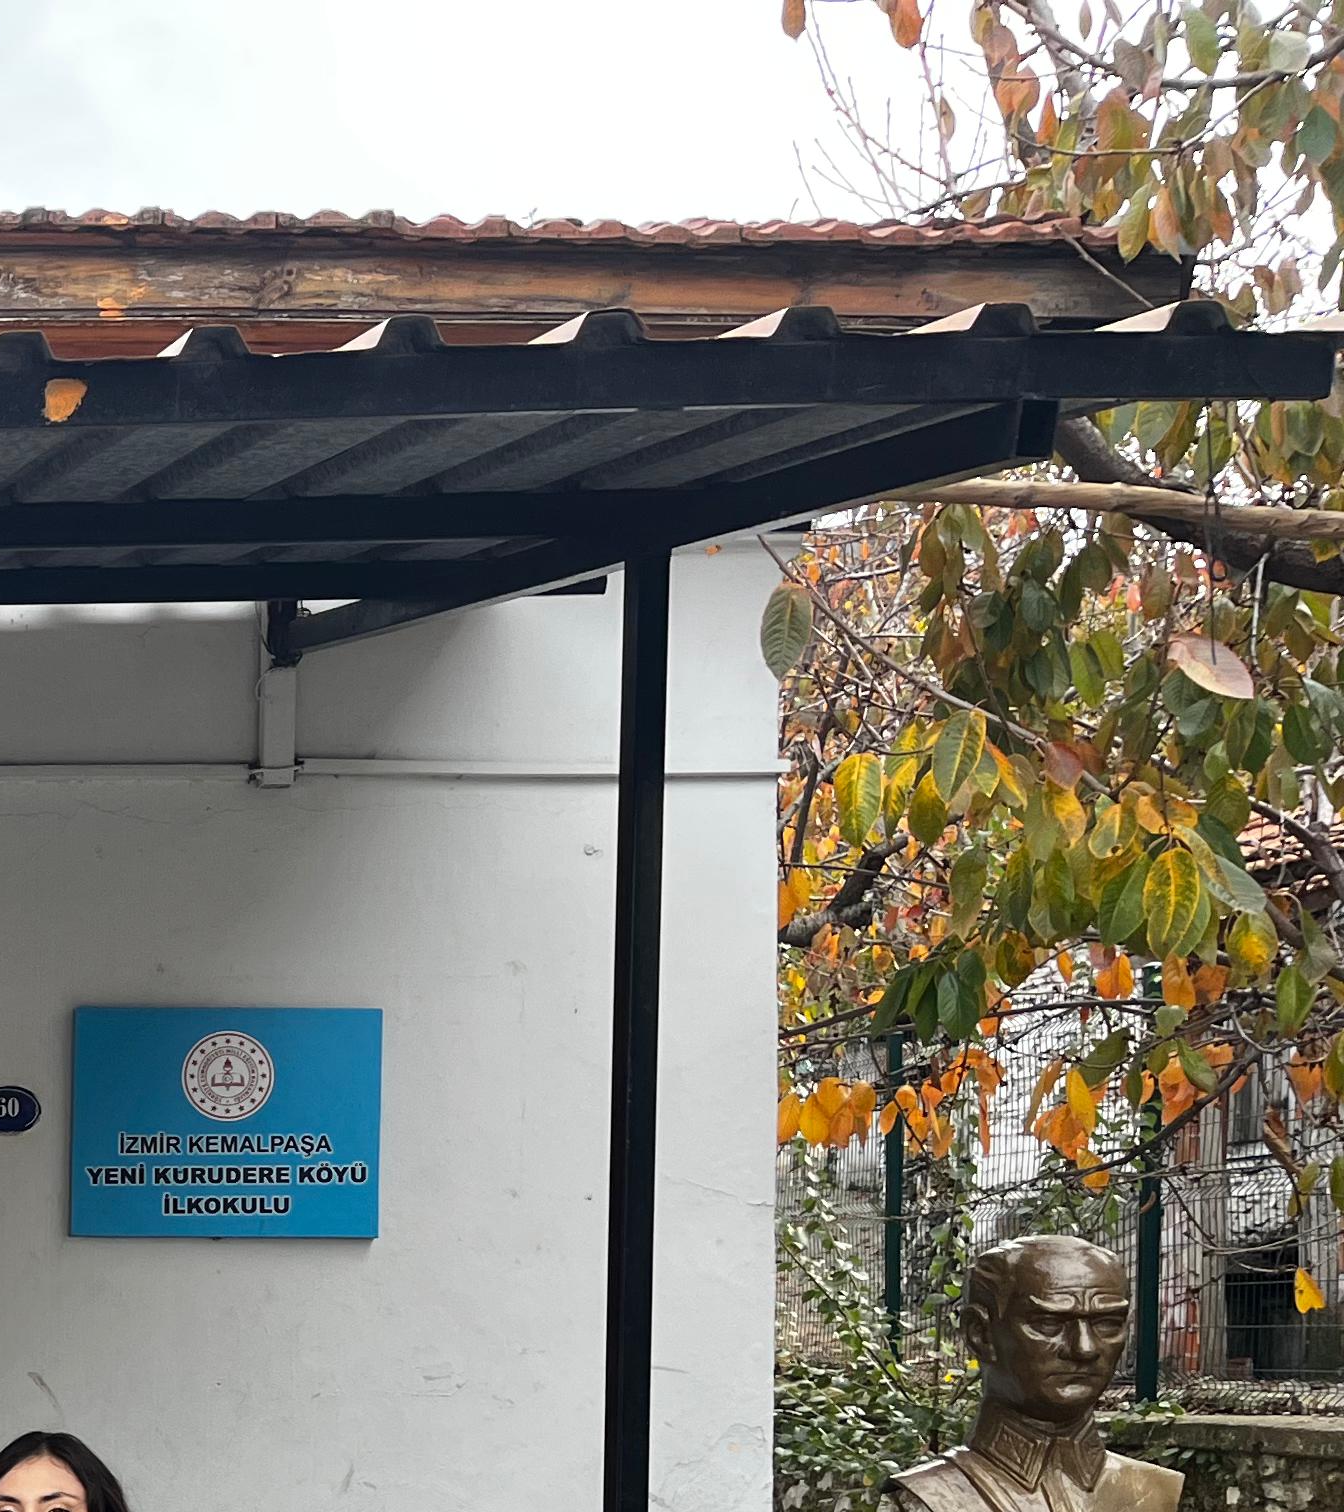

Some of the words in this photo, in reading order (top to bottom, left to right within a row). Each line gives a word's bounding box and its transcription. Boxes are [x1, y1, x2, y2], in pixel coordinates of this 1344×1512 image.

[119, 1132, 181, 1154] İZMİR
[188, 1134, 333, 1158] KEMALPAŞA
[85, 1163, 145, 1185] YENİ
[153, 1166, 291, 1185] KURUDERE
[298, 1162, 368, 1184] KÖYÜ
[162, 1193, 291, 1215] İLKOKULU
